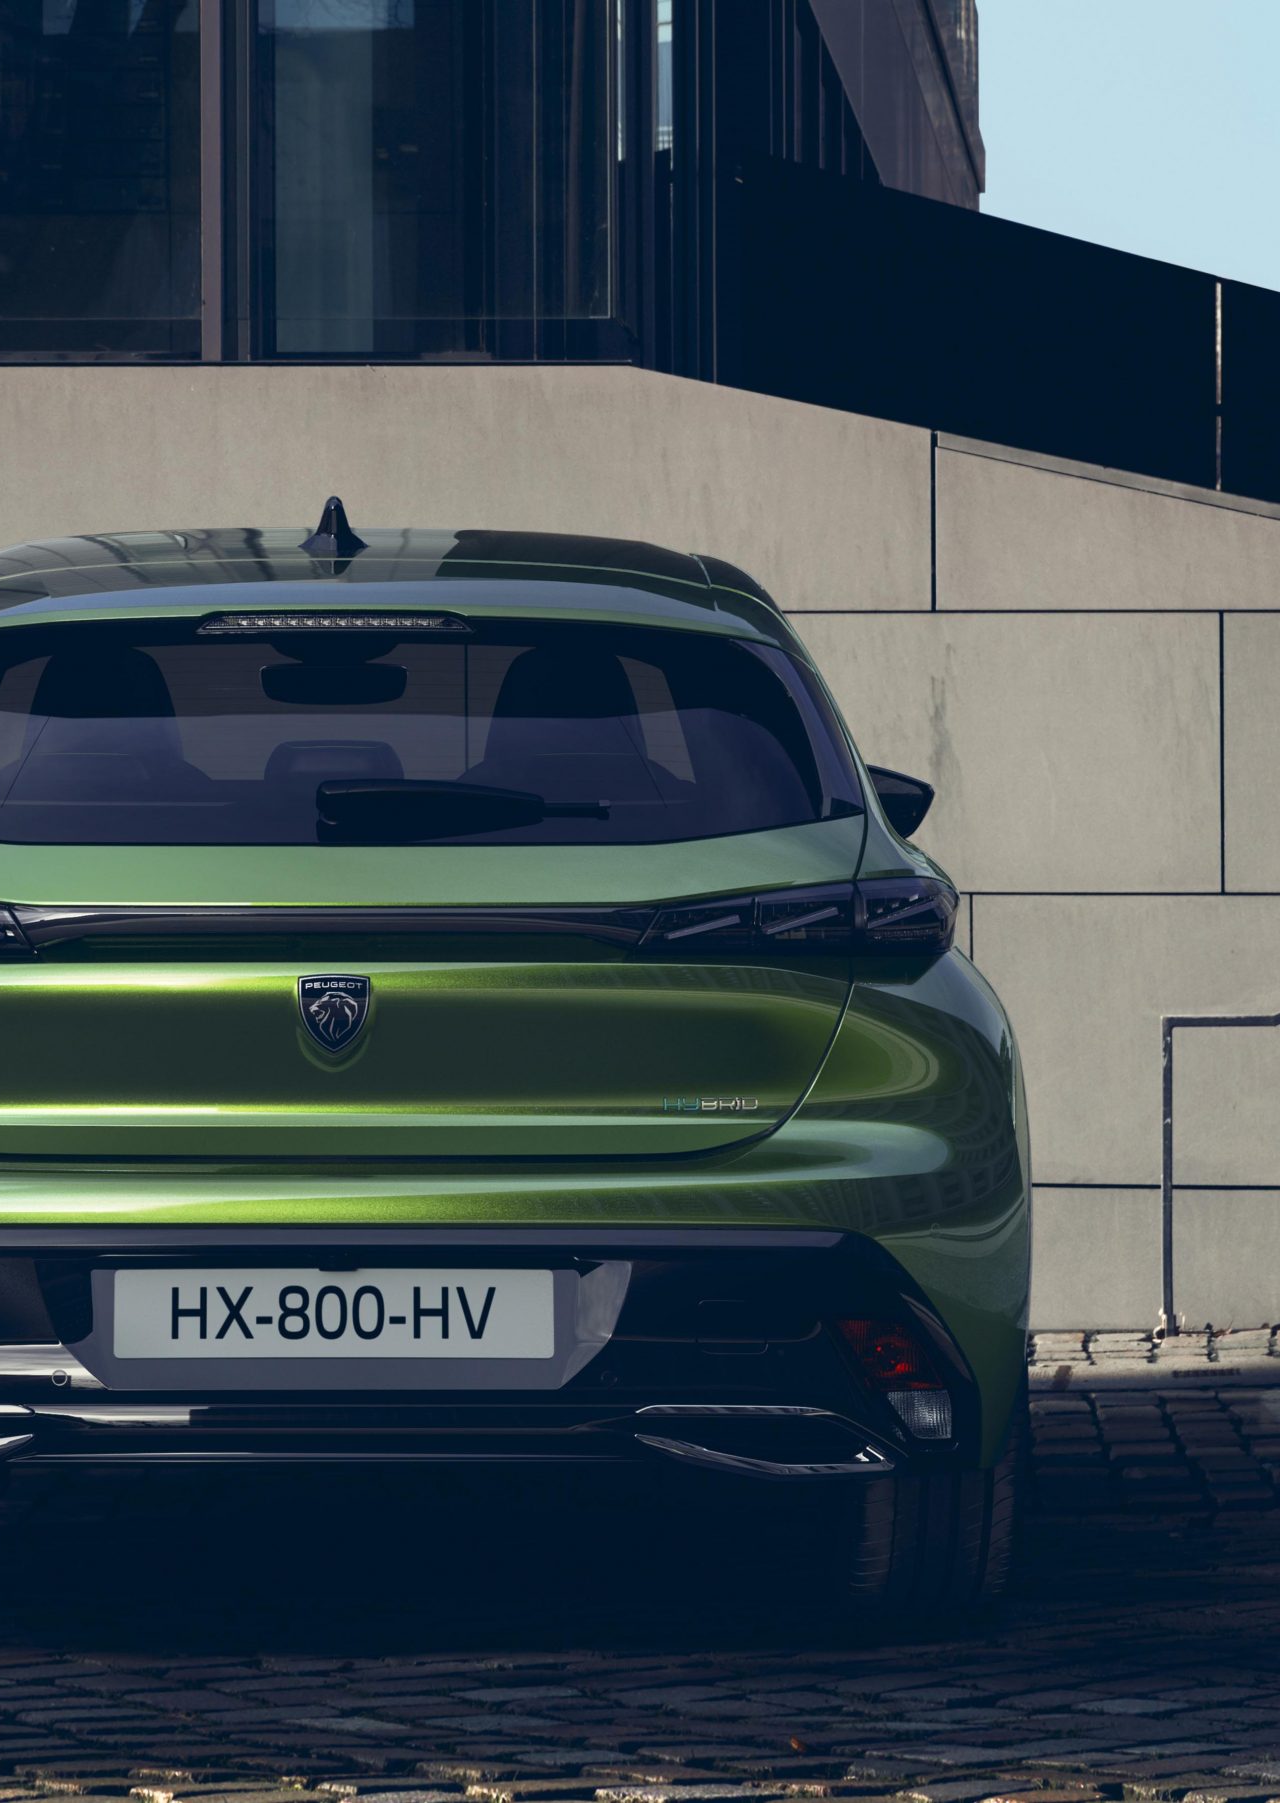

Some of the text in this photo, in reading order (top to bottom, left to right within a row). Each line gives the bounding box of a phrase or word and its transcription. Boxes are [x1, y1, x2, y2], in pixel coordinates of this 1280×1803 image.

[305, 981, 363, 990] PEUGEOT
[663, 1097, 759, 1111] HYBRID
[171, 1285, 496, 1340] HX-800-HV
